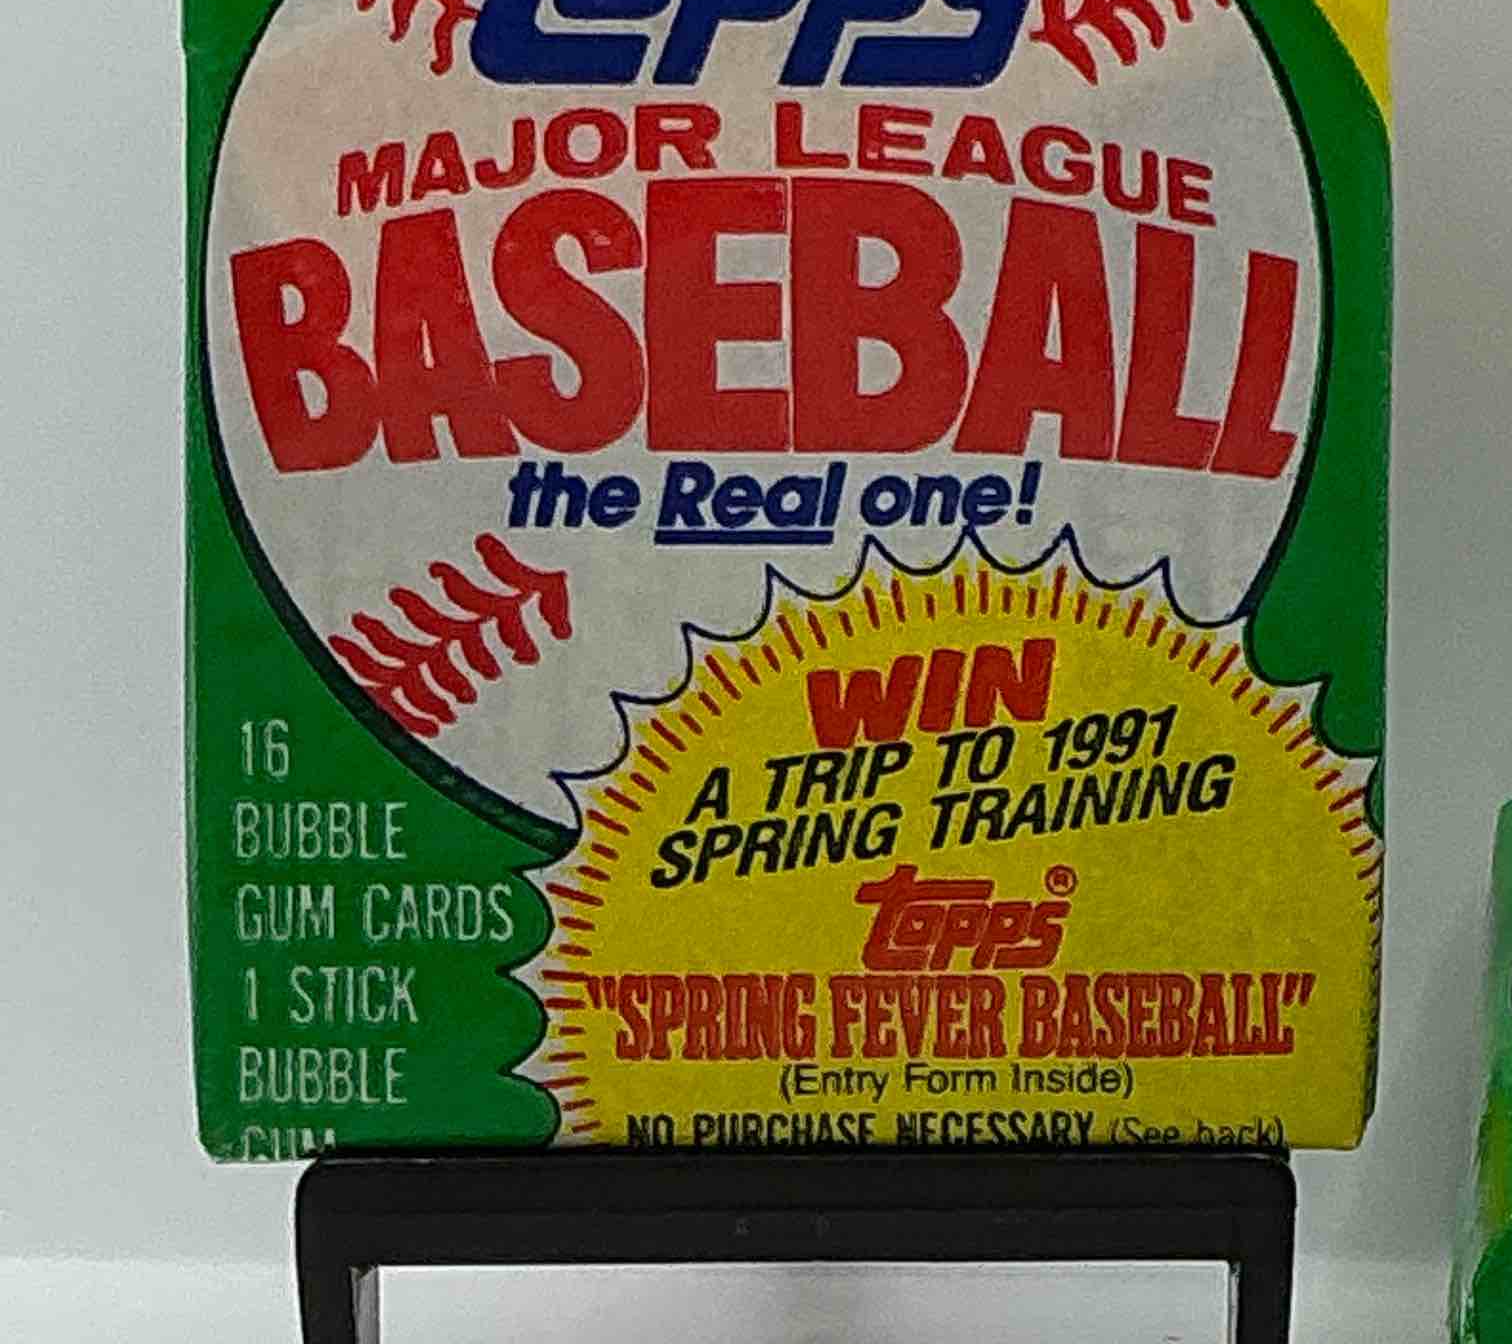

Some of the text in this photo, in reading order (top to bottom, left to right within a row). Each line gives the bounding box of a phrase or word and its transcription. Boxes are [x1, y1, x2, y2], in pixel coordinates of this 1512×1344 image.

[337, 103, 1216, 229] MAJOR LEAGUE
[229, 175, 1299, 478] BASEBALL
[508, 462, 1039, 532] the Real one!
[805, 638, 1056, 751] WIN
[240, 719, 290, 778] 16
[685, 706, 1176, 822] A TRIP TO 1991
[234, 801, 408, 860] BUBBLE
[651, 755, 1236, 889] SPRING TRAINING
[235, 884, 514, 944] GUM CARDS
[244, 966, 419, 1025] 1 STICK
[590, 972, 1316, 1060] "SPRING FEVER BASEBALL"
[238, 1047, 408, 1105] BUBBLE
[779, 1062, 1134, 1103] (Entry Form Inside)
[626, 1113, 674, 1145] NO
[693, 1112, 876, 1145] PURCHASE
[896, 1111, 1095, 1145] NECESSARY
